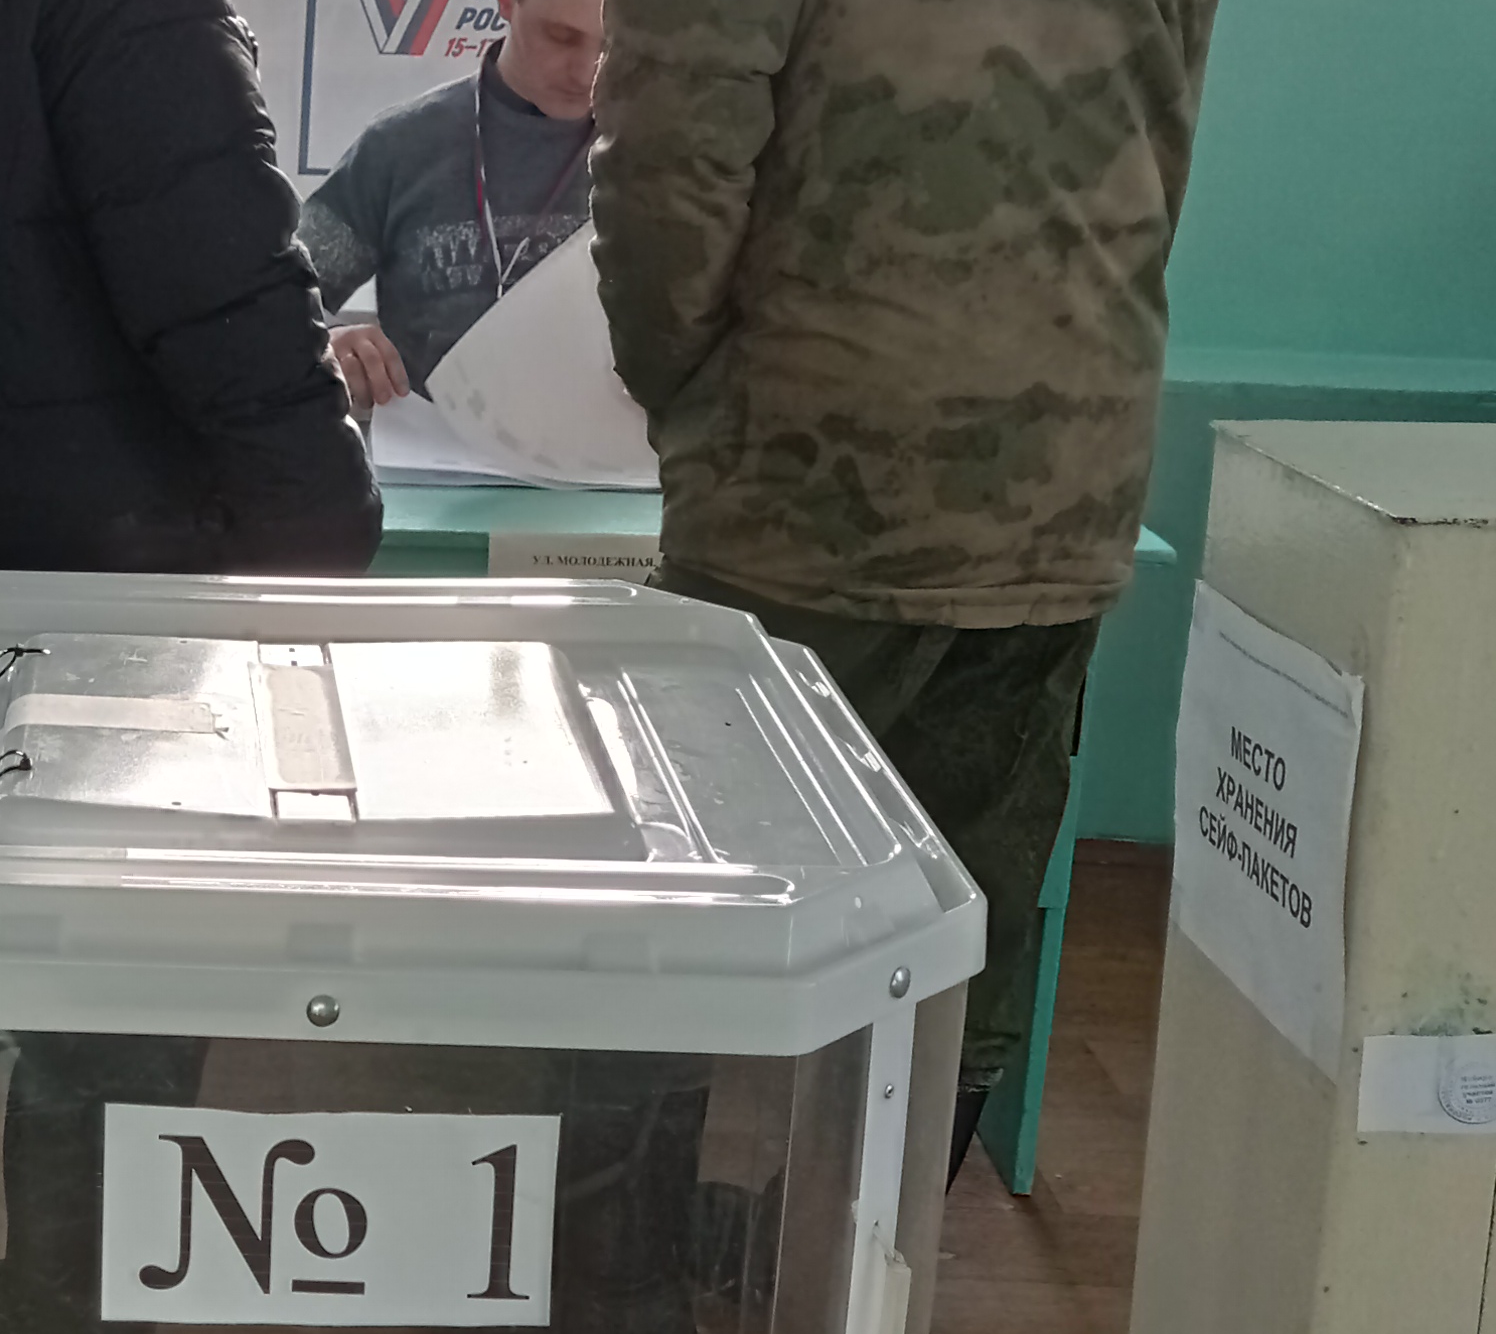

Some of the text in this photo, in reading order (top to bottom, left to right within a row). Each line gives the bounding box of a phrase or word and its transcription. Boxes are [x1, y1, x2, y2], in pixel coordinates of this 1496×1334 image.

[532, 555, 554, 566] УЛ.
[1230, 726, 1287, 792] МЕСТО
[1215, 766, 1298, 859] ХРАНЕНИЯ
[1198, 805, 1313, 929] СЕЙФ-ПАКЕТОВ
[466, 1143, 531, 1300] 1
